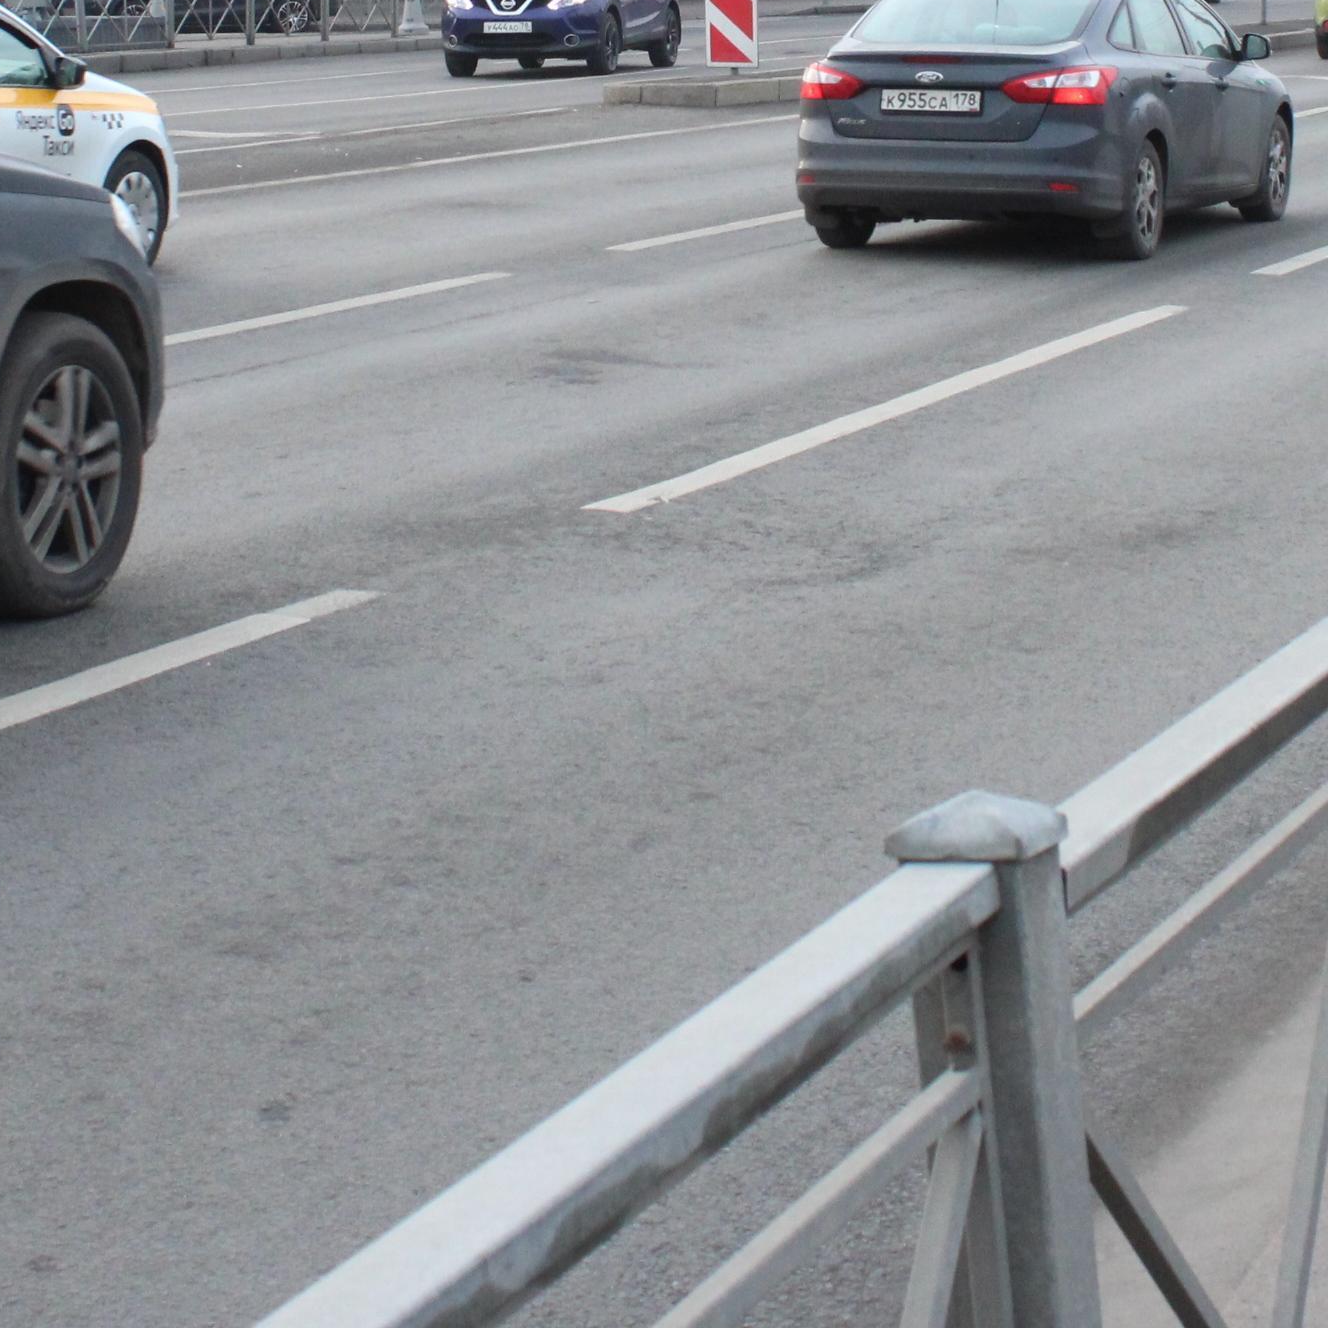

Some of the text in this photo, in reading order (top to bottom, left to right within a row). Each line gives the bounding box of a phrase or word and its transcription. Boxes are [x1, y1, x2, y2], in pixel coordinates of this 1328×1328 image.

[886, 92, 977, 110] К955СА 178
[42, 135, 74, 156] Такси
